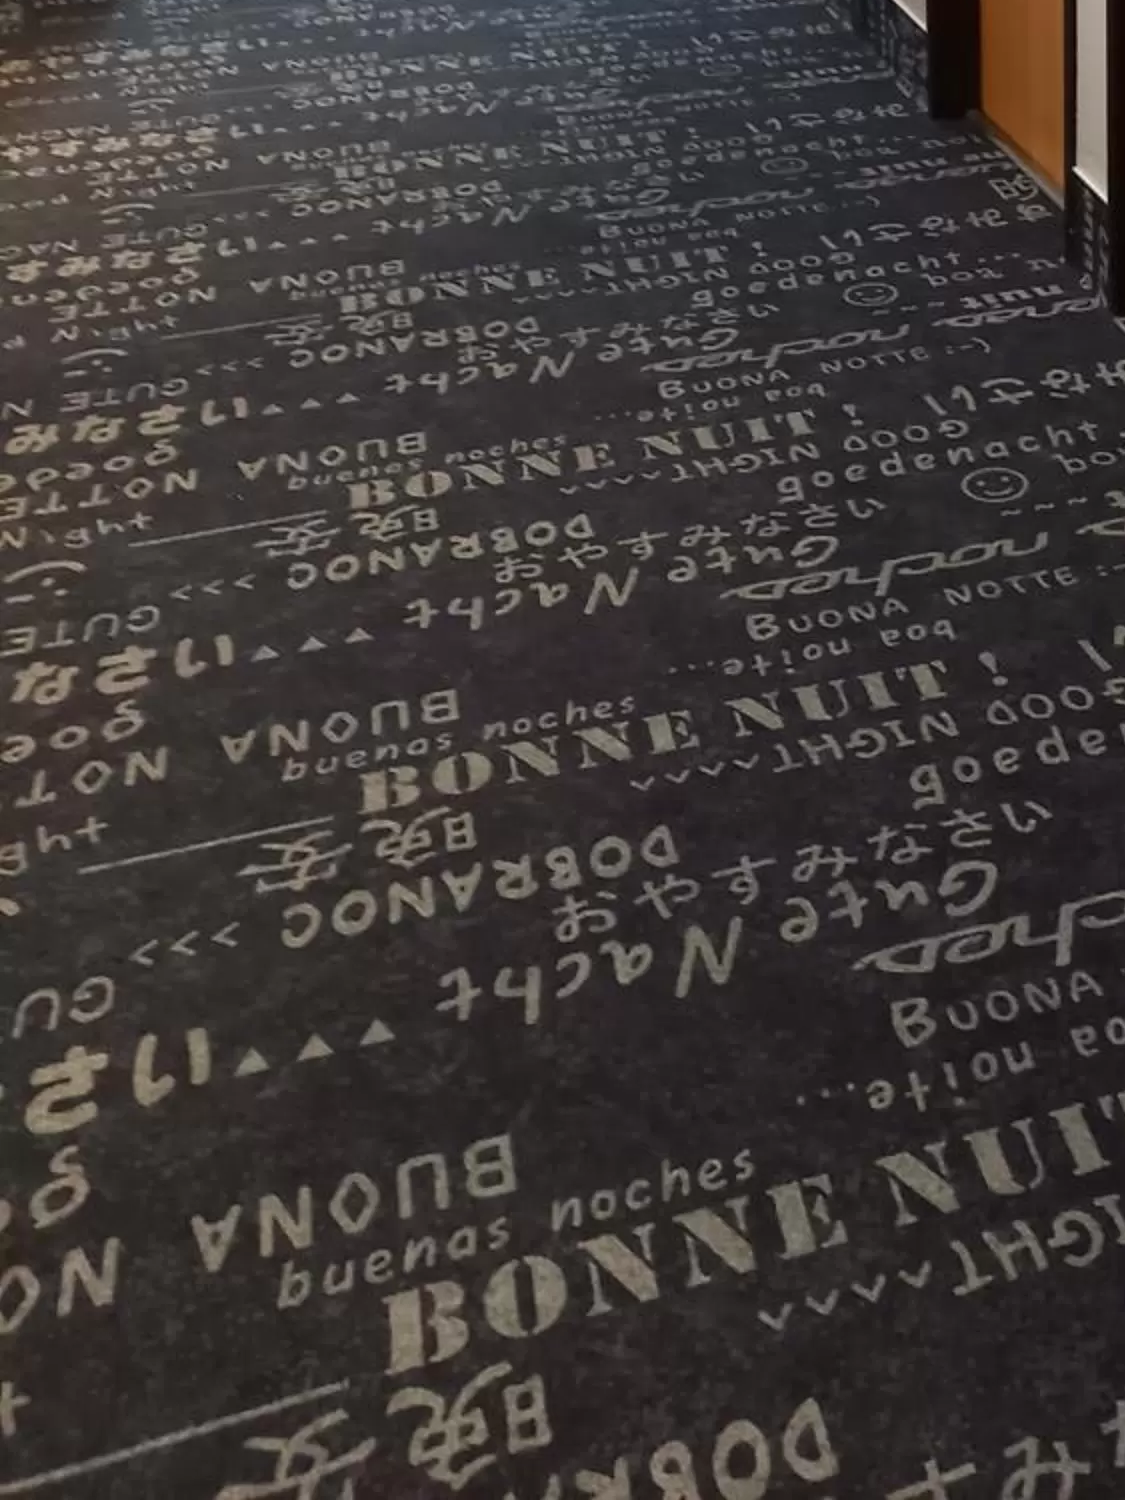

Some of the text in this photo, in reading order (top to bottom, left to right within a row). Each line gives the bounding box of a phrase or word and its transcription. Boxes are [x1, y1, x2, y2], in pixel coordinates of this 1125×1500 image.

[220, 689, 459, 763] BUONA
[358, 710, 699, 814] BONNE
[724, 660, 947, 737] NUIT
[773, 711, 959, 772] NIGHT
[780, 861, 997, 942] Gute
[891, 971, 1103, 1048] BUONA
[192, 1134, 516, 1272] BUONA
[382, 1174, 847, 1375] BONNE
